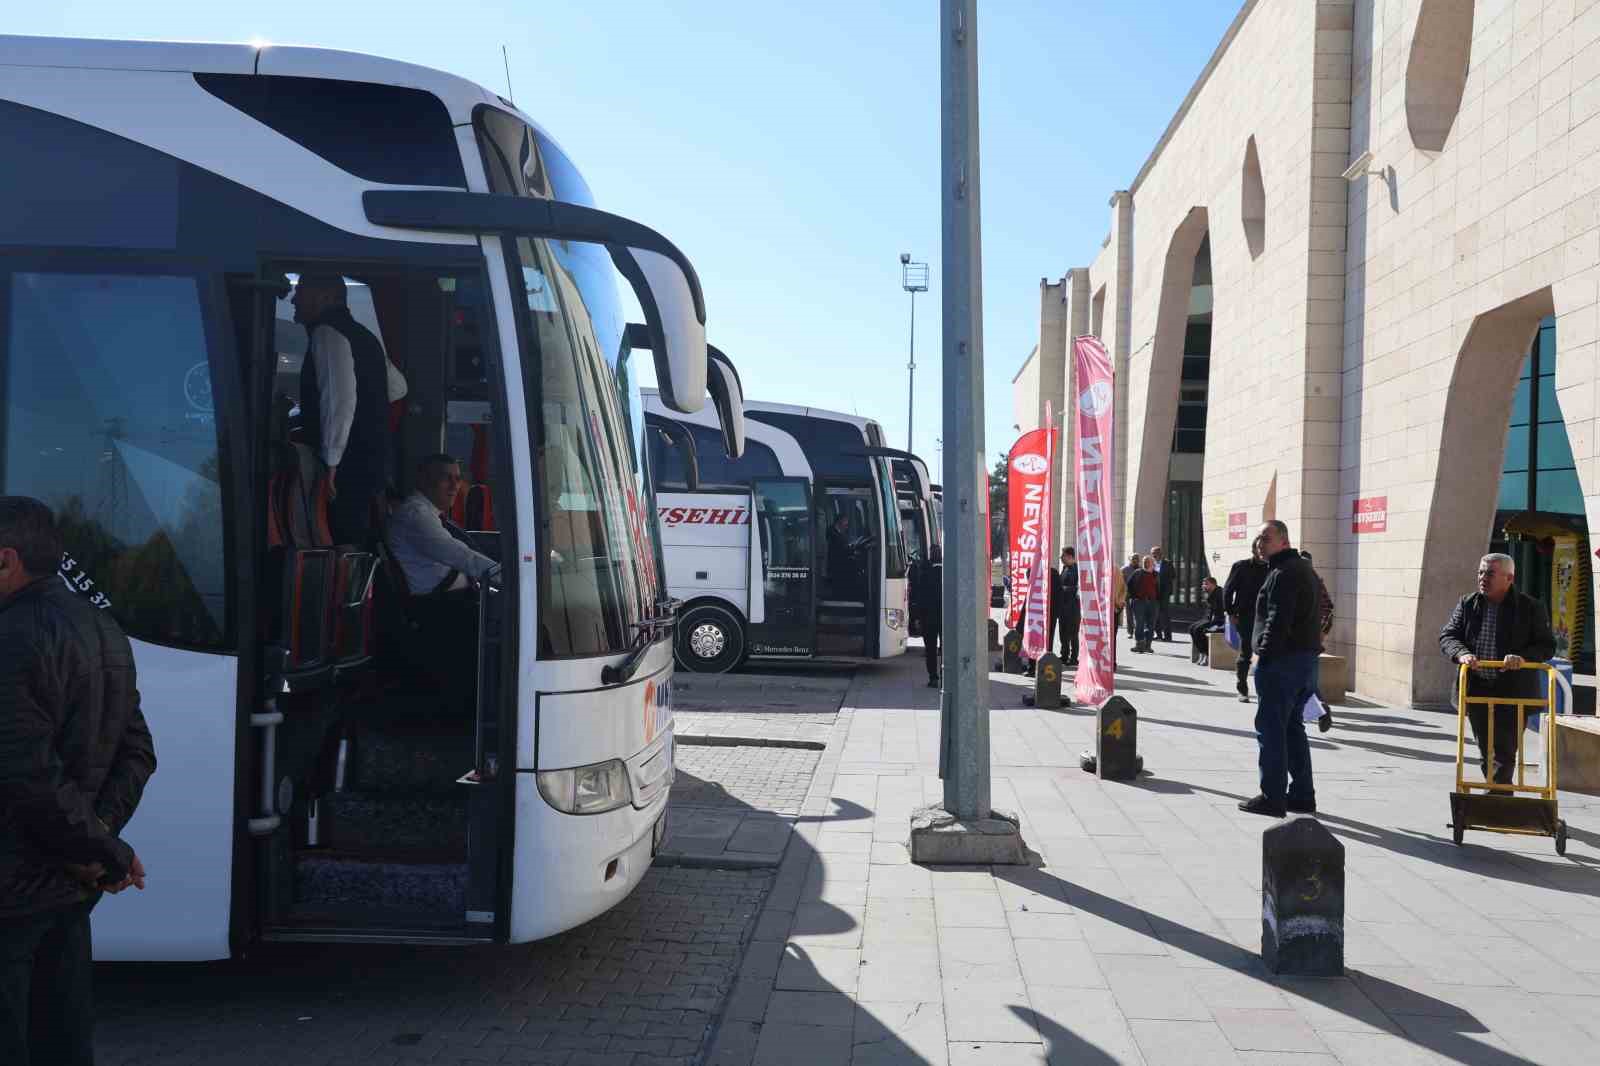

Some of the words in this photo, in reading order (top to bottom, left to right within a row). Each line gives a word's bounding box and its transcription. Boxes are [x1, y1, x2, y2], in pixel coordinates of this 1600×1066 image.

[72, 571, 94, 591] 15
[90, 592, 112, 608] 37
[1043, 664, 1057, 682] 5
[1103, 718, 1124, 740] 4
